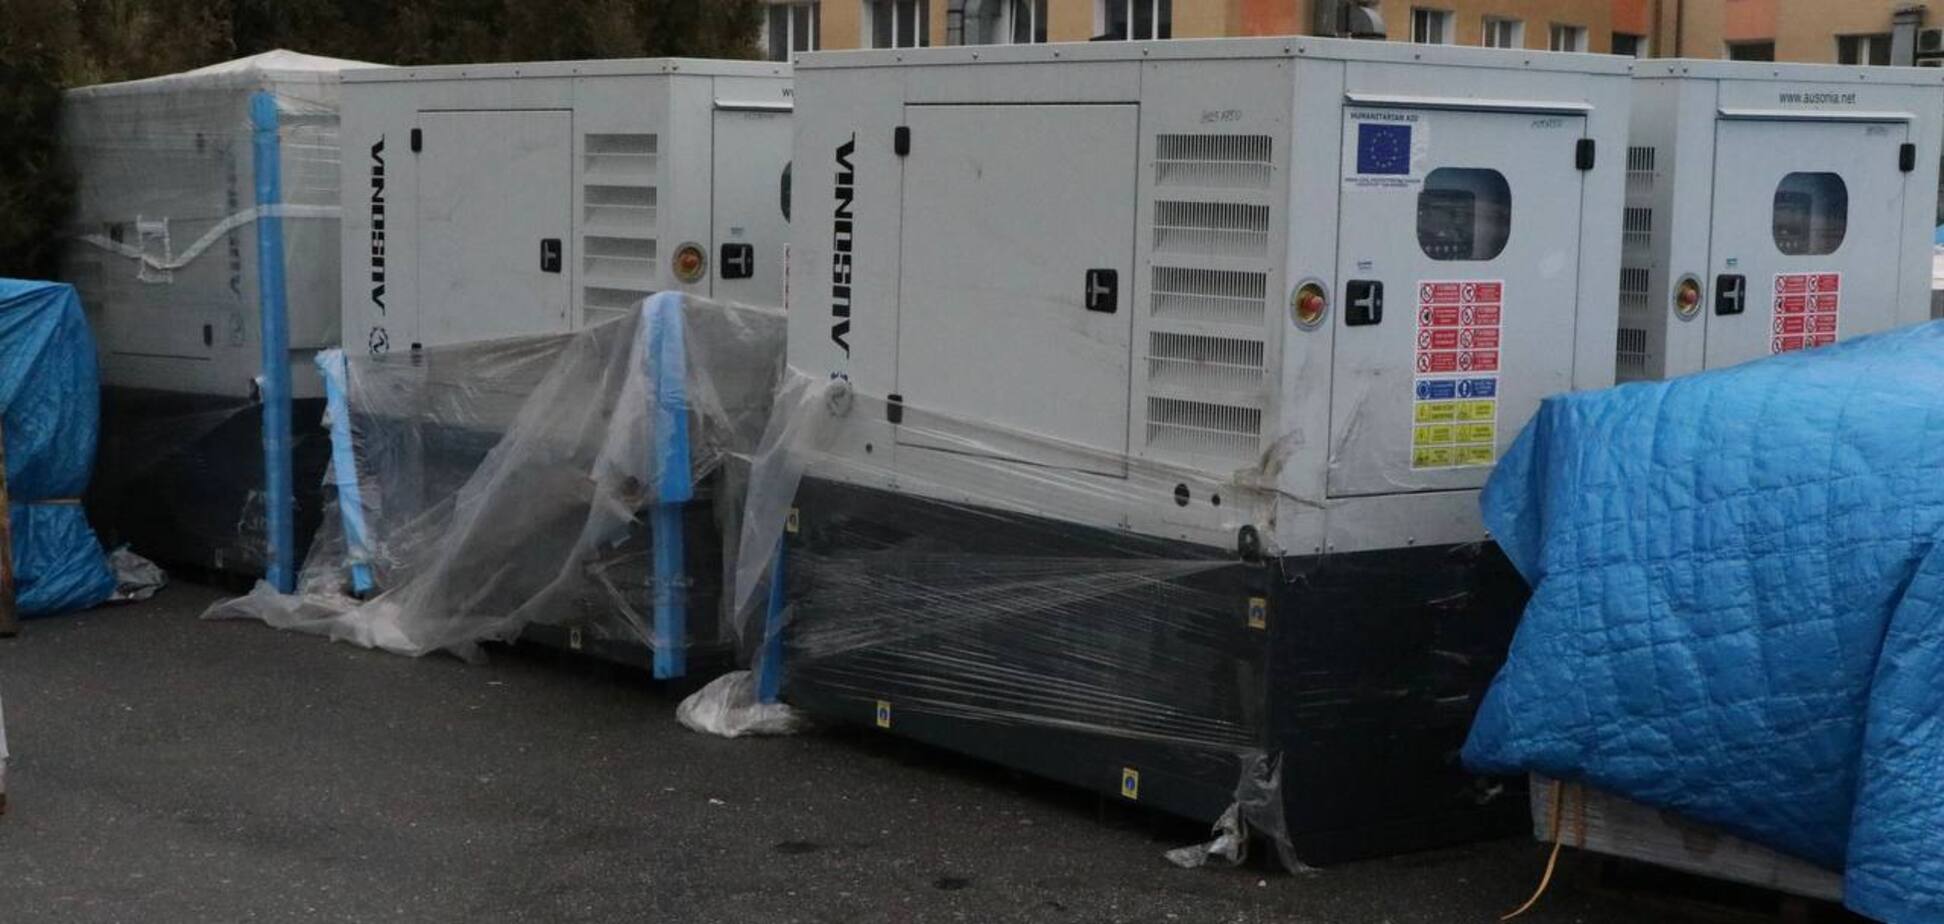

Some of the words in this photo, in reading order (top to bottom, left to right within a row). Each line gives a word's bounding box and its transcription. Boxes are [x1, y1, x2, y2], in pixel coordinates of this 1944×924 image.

[1350, 112, 1404, 121] HUMANITARIAN
[1779, 92, 1856, 104] www.ausonia.net
[371, 133, 385, 317] AUSONIA
[831, 131, 855, 360] AUSONIA
